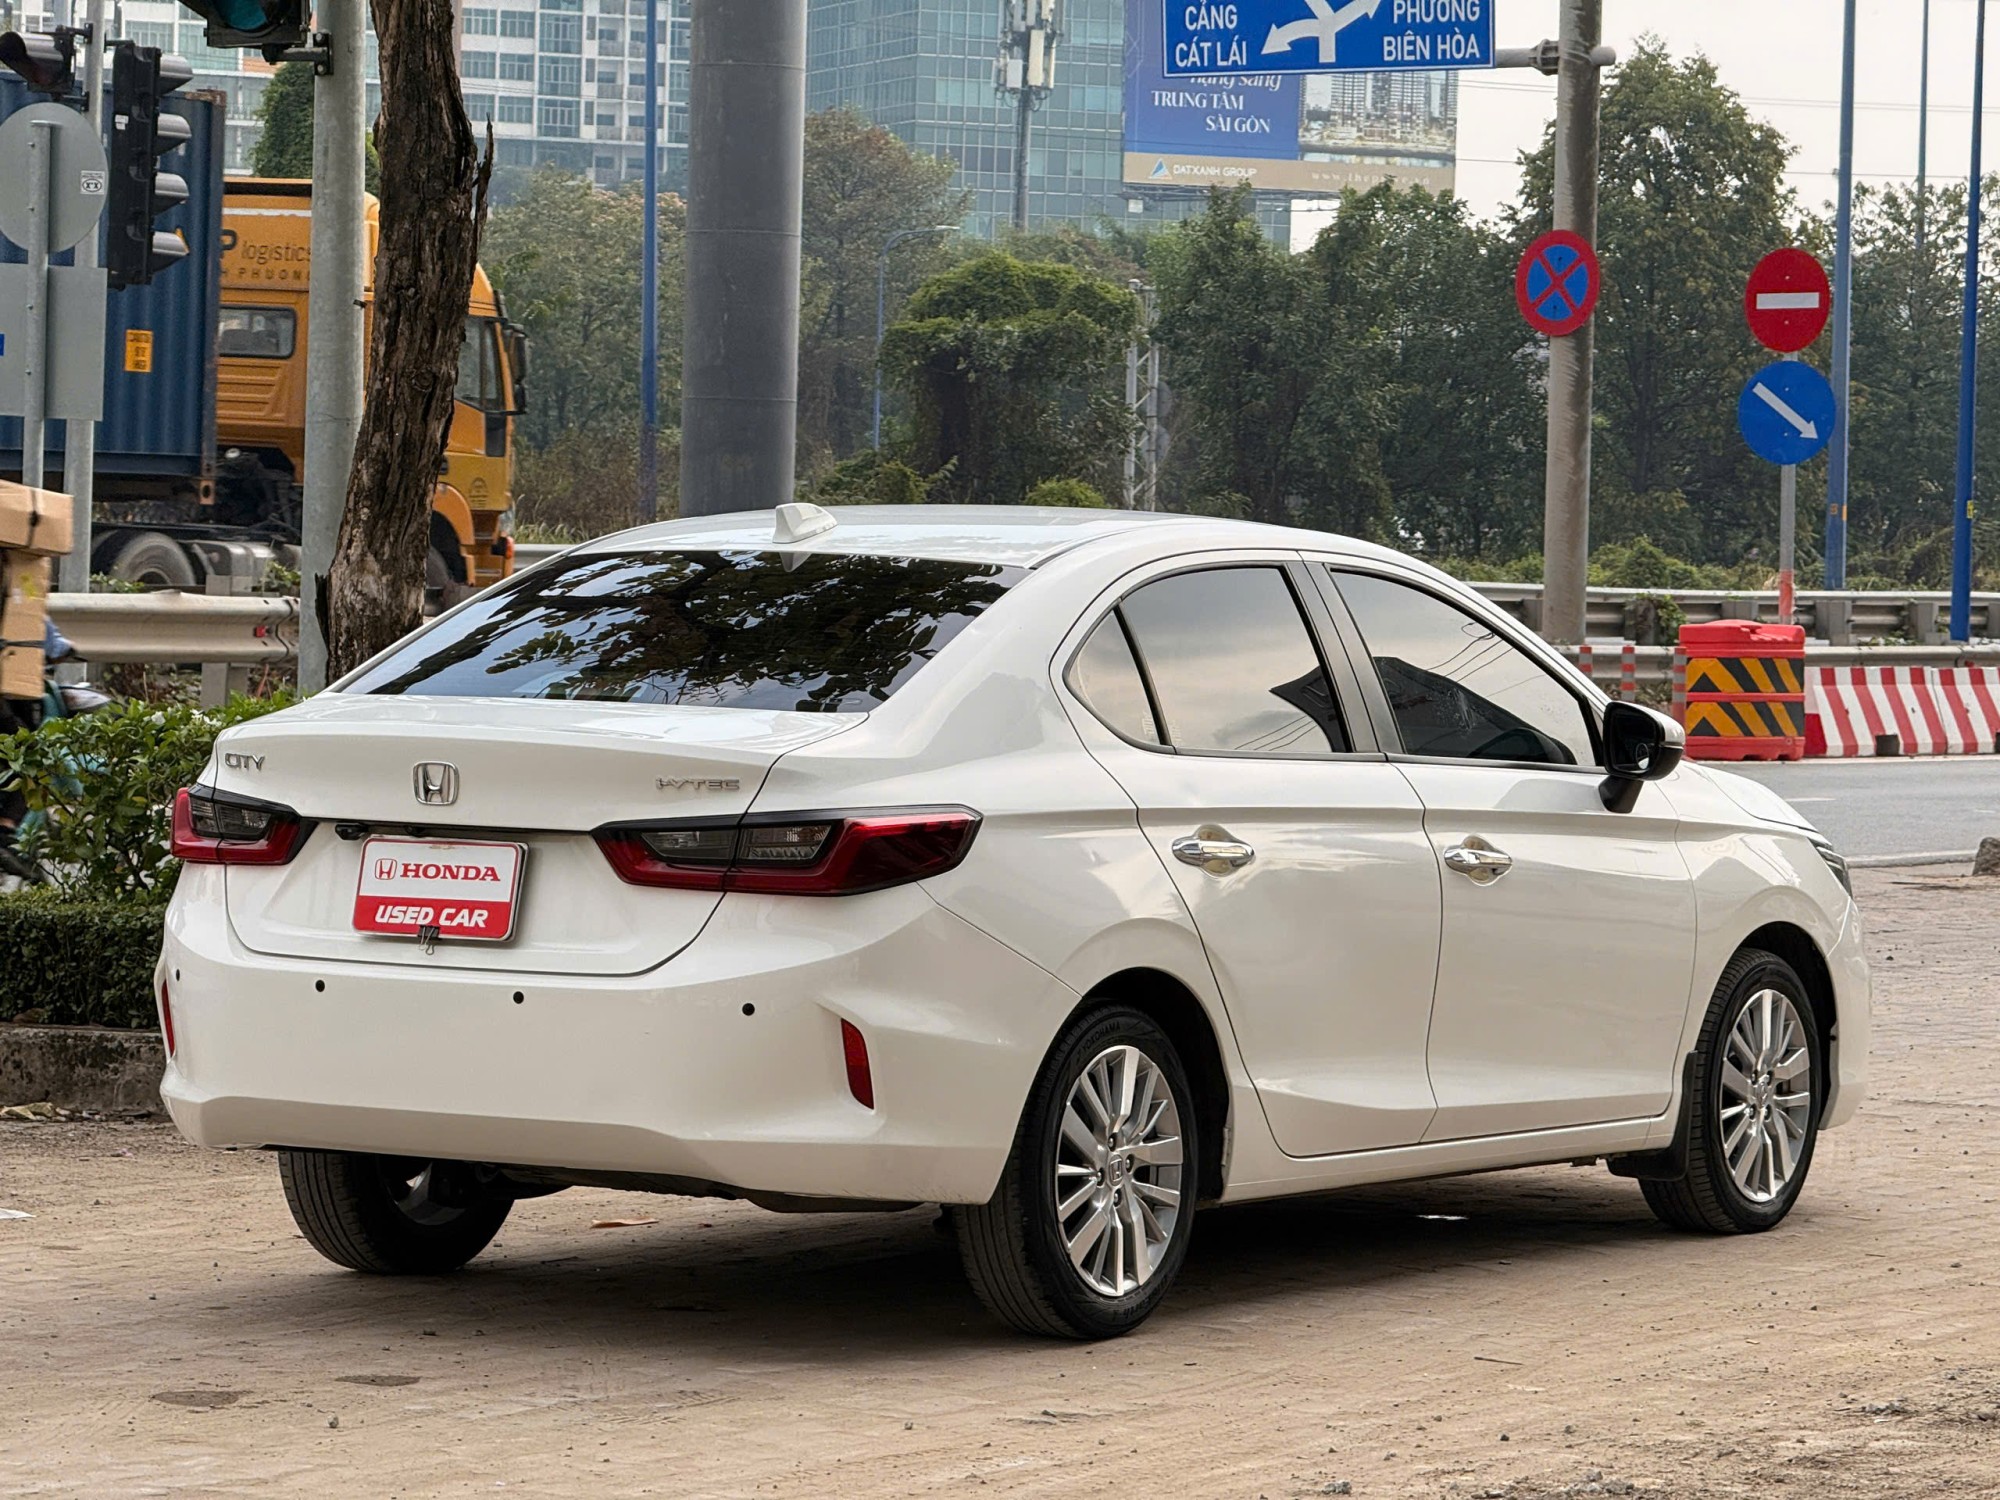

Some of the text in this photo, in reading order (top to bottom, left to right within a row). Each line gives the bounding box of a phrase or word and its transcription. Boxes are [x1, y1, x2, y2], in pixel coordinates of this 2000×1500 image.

[1175, 35, 1247, 67] CÁT LÁI
[1383, 27, 1480, 61] BIÊN HÒA
[1151, 90, 1244, 110] TRUNG TÂM
[1205, 113, 1270, 133] SÀI GÒN
[1222, 166, 1258, 178] GROUP
[225, 753, 265, 771] CITY
[400, 863, 501, 882] HONDA
[375, 904, 488, 928] USED CAR
